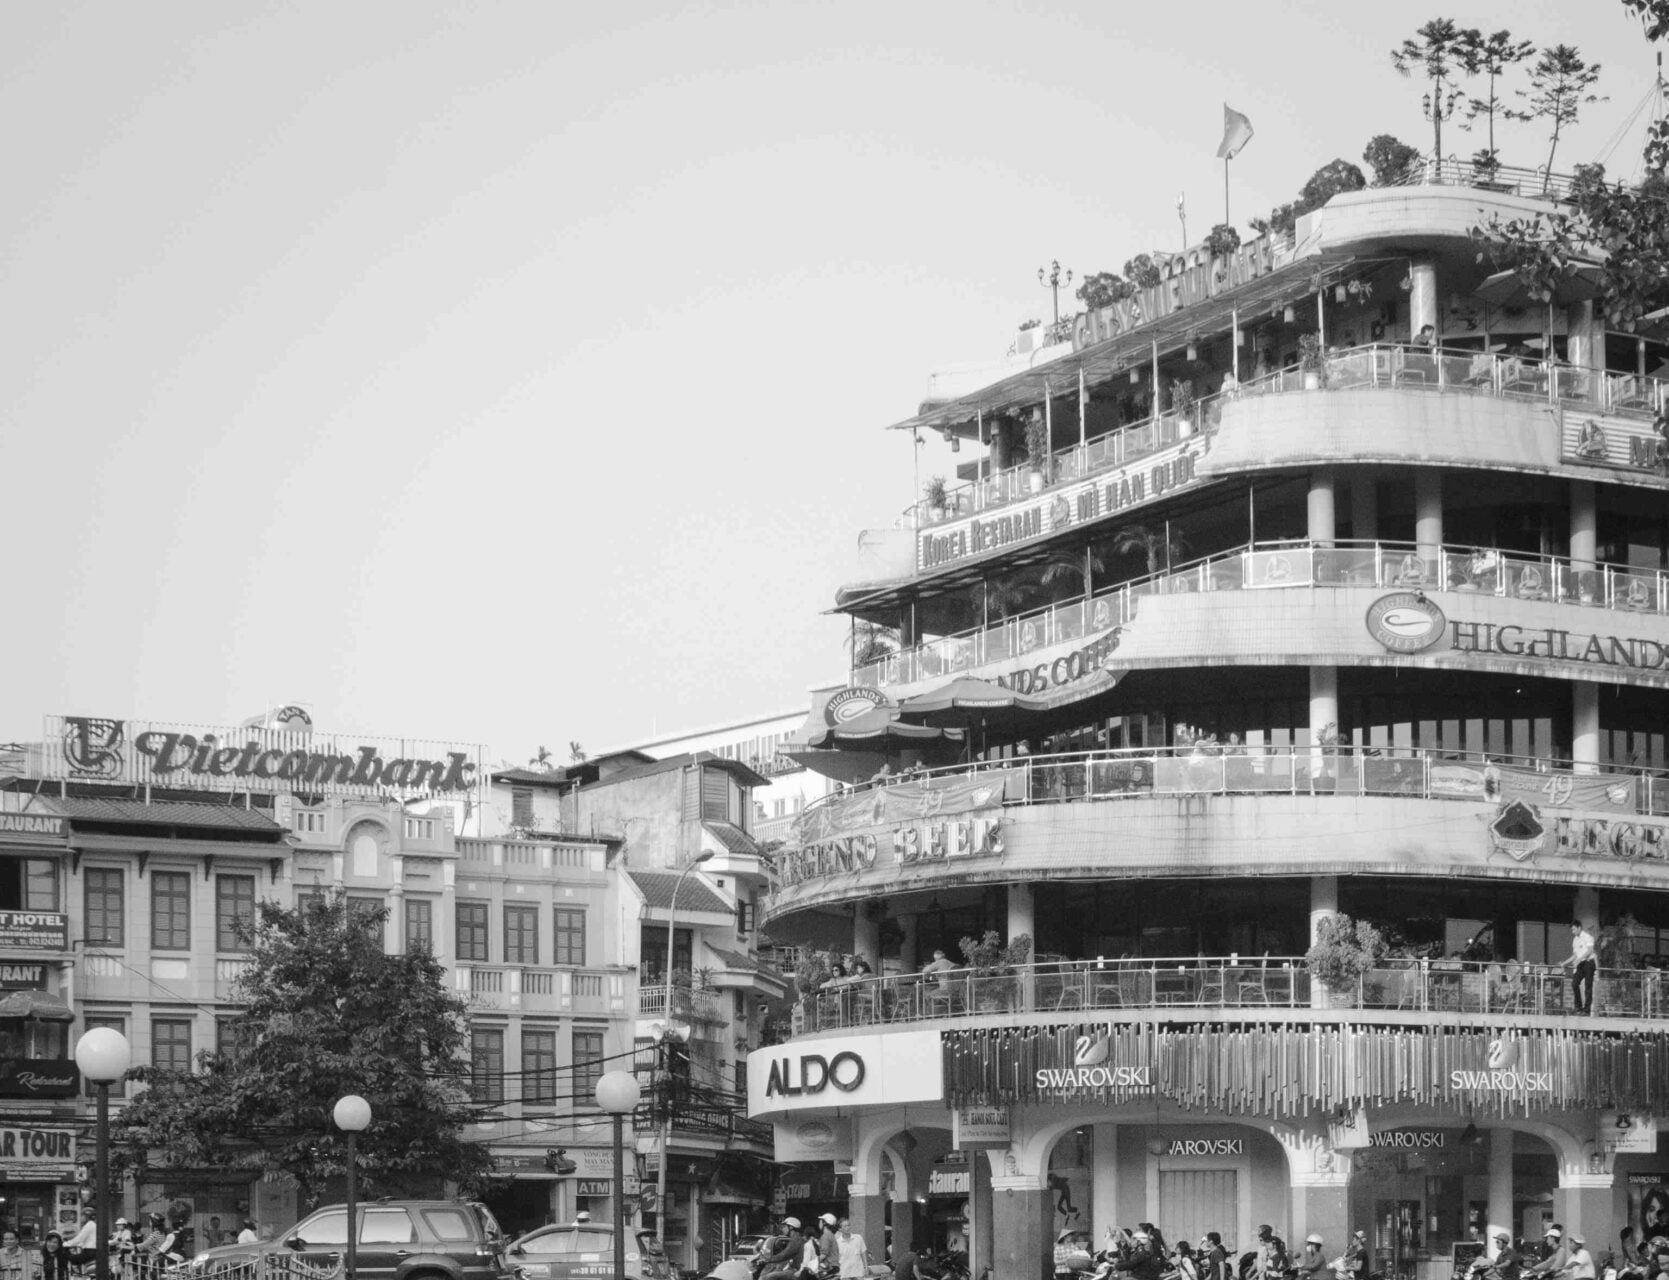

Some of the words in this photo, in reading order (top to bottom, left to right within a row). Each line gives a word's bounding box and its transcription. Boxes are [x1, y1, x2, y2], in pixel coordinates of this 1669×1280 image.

[922, 530, 967, 567] KOREA
[970, 507, 1042, 554] RESTARAN
[996, 663, 1048, 695] NDS
[828, 689, 880, 711] HIGHLANDS
[135, 731, 477, 791] Vietcombank
[1542, 776, 1573, 806] 49
[893, 818, 1004, 862] BEER
[13, 914, 65, 927] HOTEL
[765, 1051, 865, 1097] ALDO
[1036, 1066, 1150, 1088] SWAROVSKI
[1450, 1070, 1553, 1091] SWAROVSKI
[0, 1131, 16, 1157] R
[20, 1131, 71, 1158] TOUR
[1169, 1139, 1243, 1155] AROVSKI
[578, 1181, 609, 1194] ATM
[1629, 1176, 1661, 1184] SWAROVSKI
